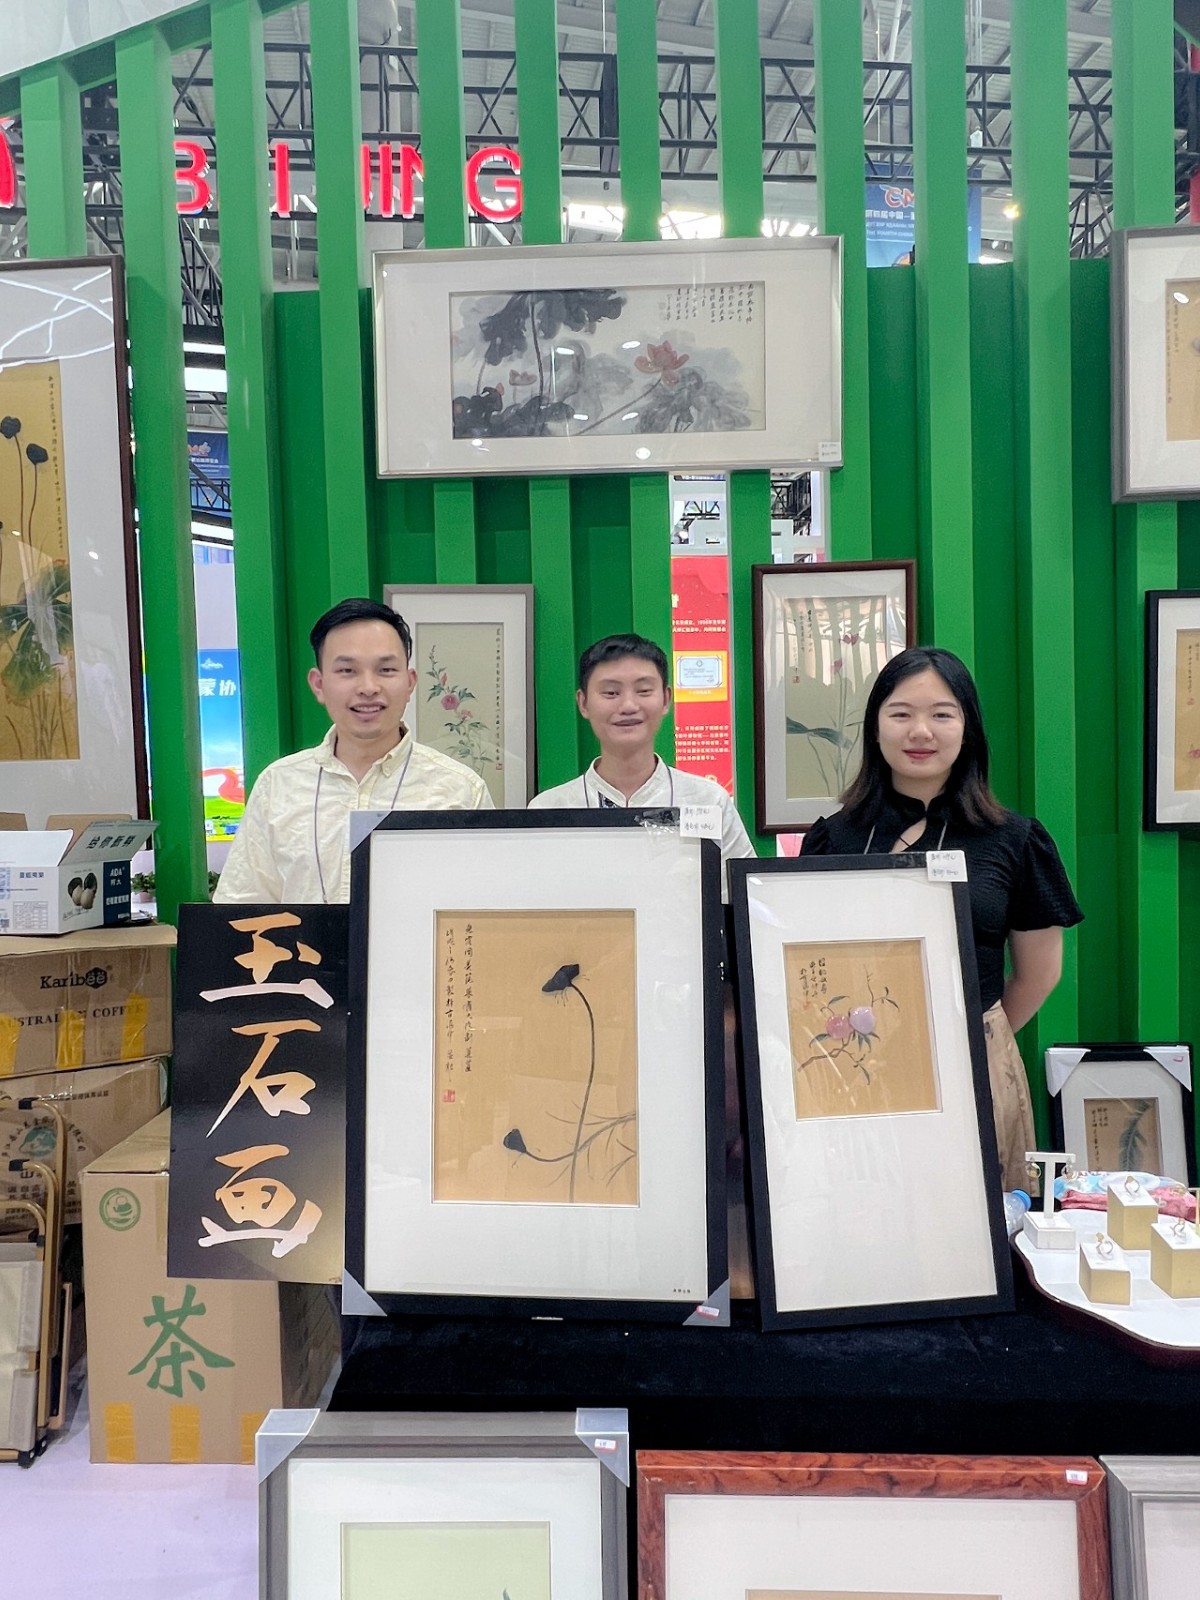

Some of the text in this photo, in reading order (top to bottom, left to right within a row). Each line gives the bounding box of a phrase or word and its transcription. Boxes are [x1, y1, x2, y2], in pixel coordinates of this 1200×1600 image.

[198, 912, 334, 1258] 玉石画
[128, 1284, 235, 1397] 茶
